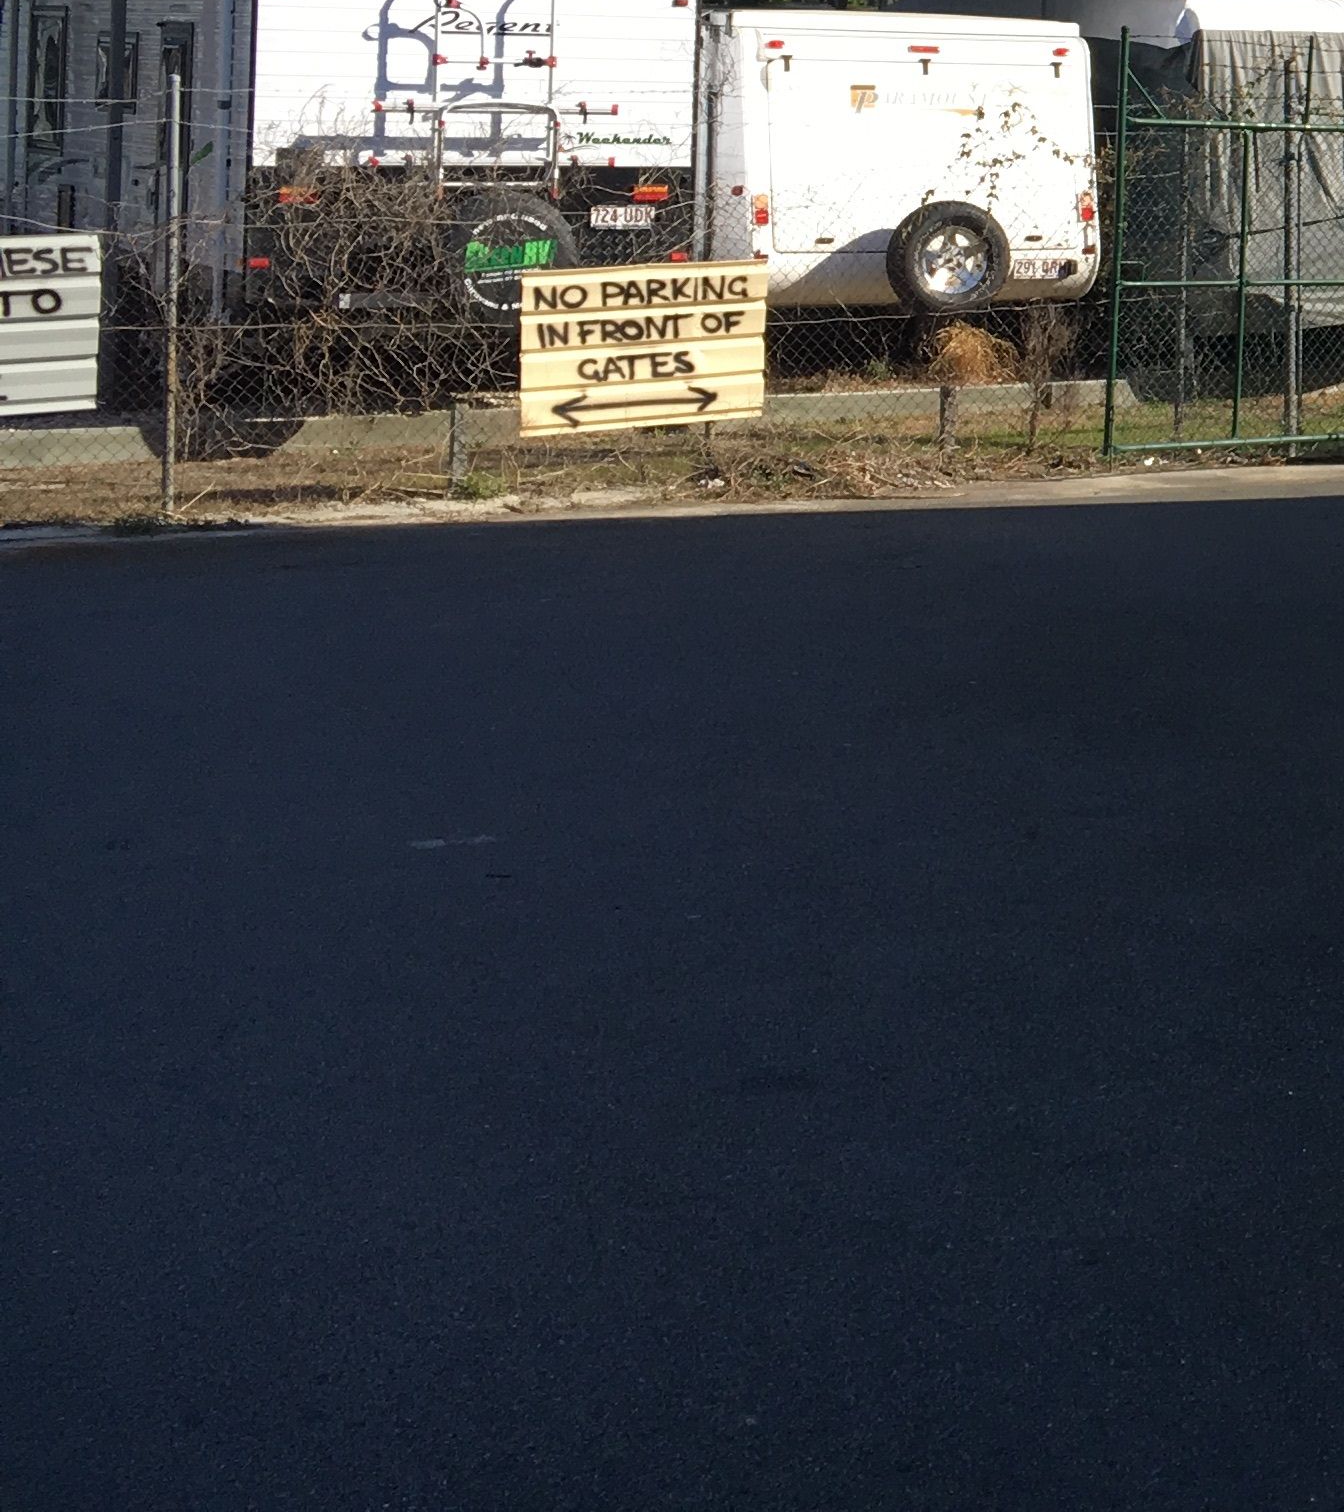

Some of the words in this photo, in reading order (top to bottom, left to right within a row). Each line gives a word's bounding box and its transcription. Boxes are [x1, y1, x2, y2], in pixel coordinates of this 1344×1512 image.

[577, 131, 671, 145] Weekender
[533, 285, 587, 310] NO
[601, 275, 748, 307] PARKING
[537, 321, 569, 348] IN
[577, 313, 694, 345] FRONT
[700, 311, 745, 334] OF
[577, 351, 696, 382] GATES
